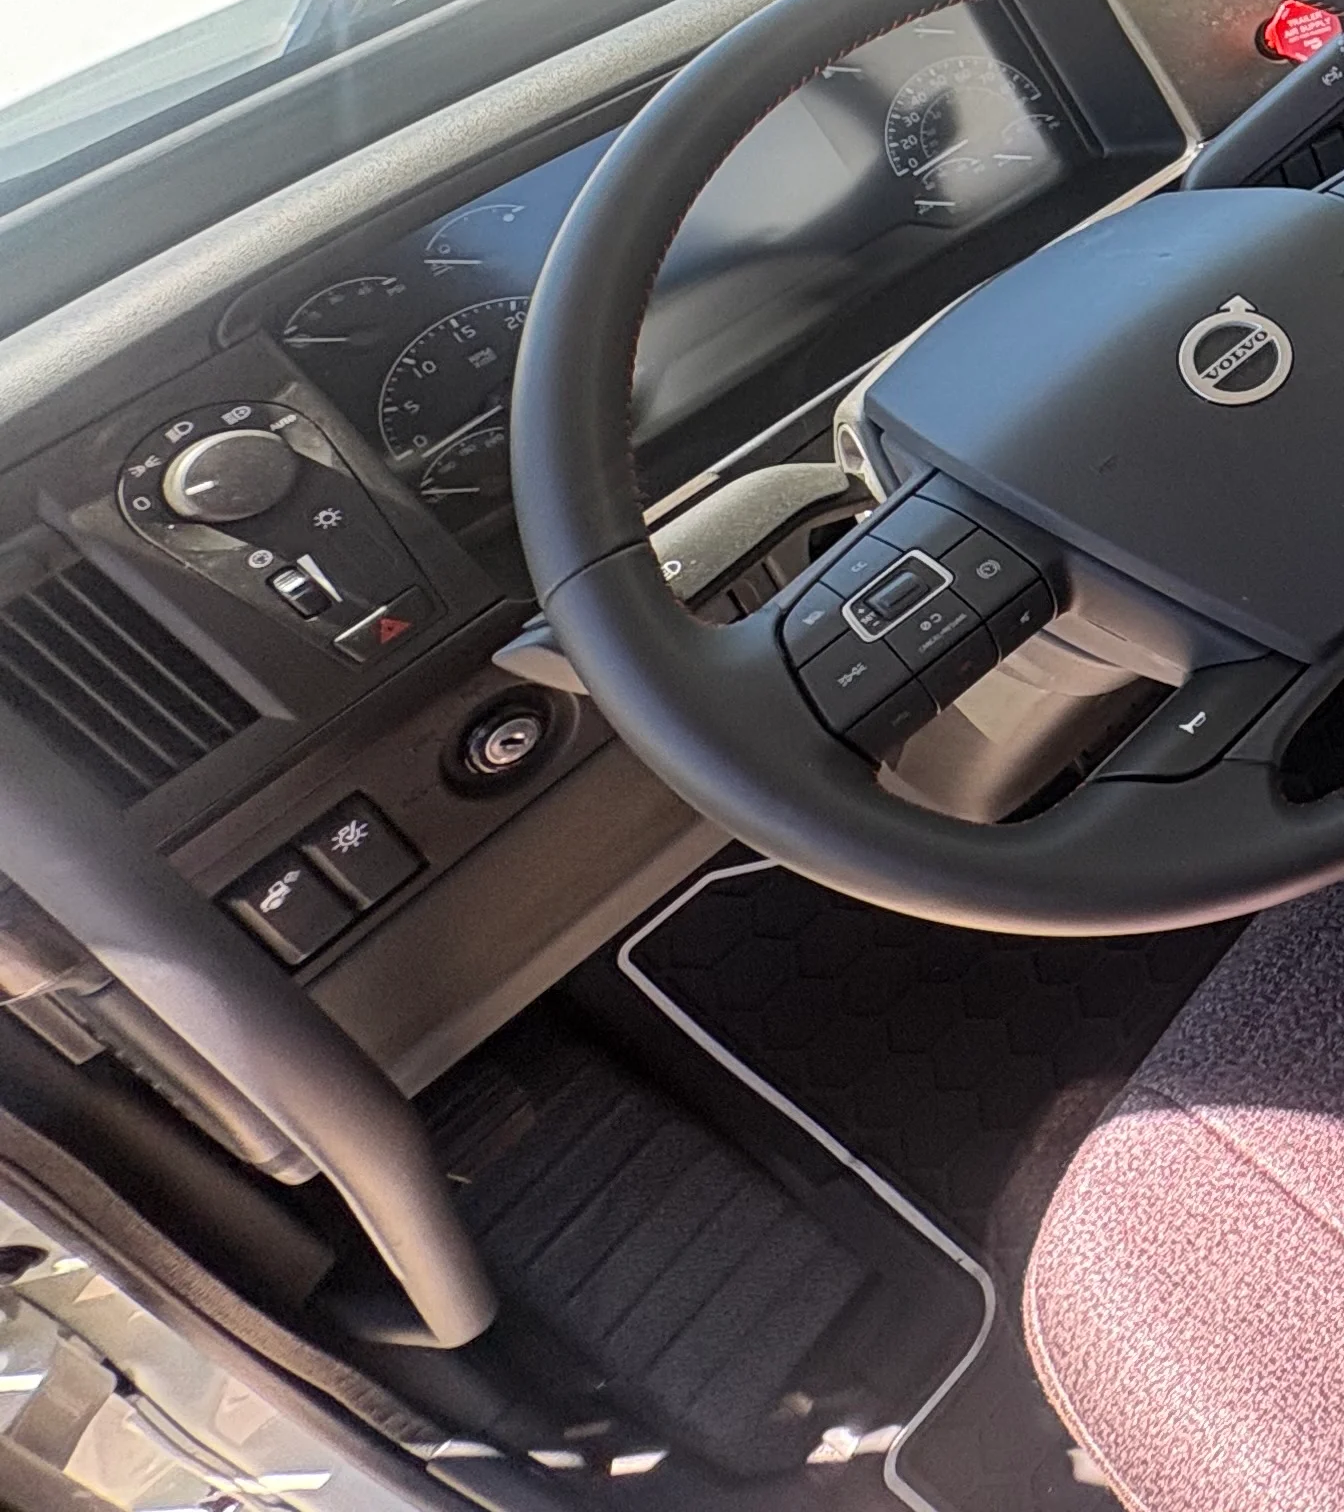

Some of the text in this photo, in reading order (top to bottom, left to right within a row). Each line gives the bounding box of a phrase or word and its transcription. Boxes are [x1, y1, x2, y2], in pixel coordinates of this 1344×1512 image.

[1287, 10, 1322, 27] TRAILER
[1300, 17, 1331, 33] SUPPLY
[910, 91, 927, 106] 40
[902, 111, 921, 128] 30
[900, 133, 918, 151] 20
[908, 158, 919, 169] 0
[504, 310, 528, 331] 20
[453, 324, 477, 343] 15
[1201, 331, 1268, 380] VOLVO
[413, 359, 437, 379] 10
[404, 399, 420, 415] 5
[269, 413, 298, 432] AUTO
[413, 434, 428, 448] 0
